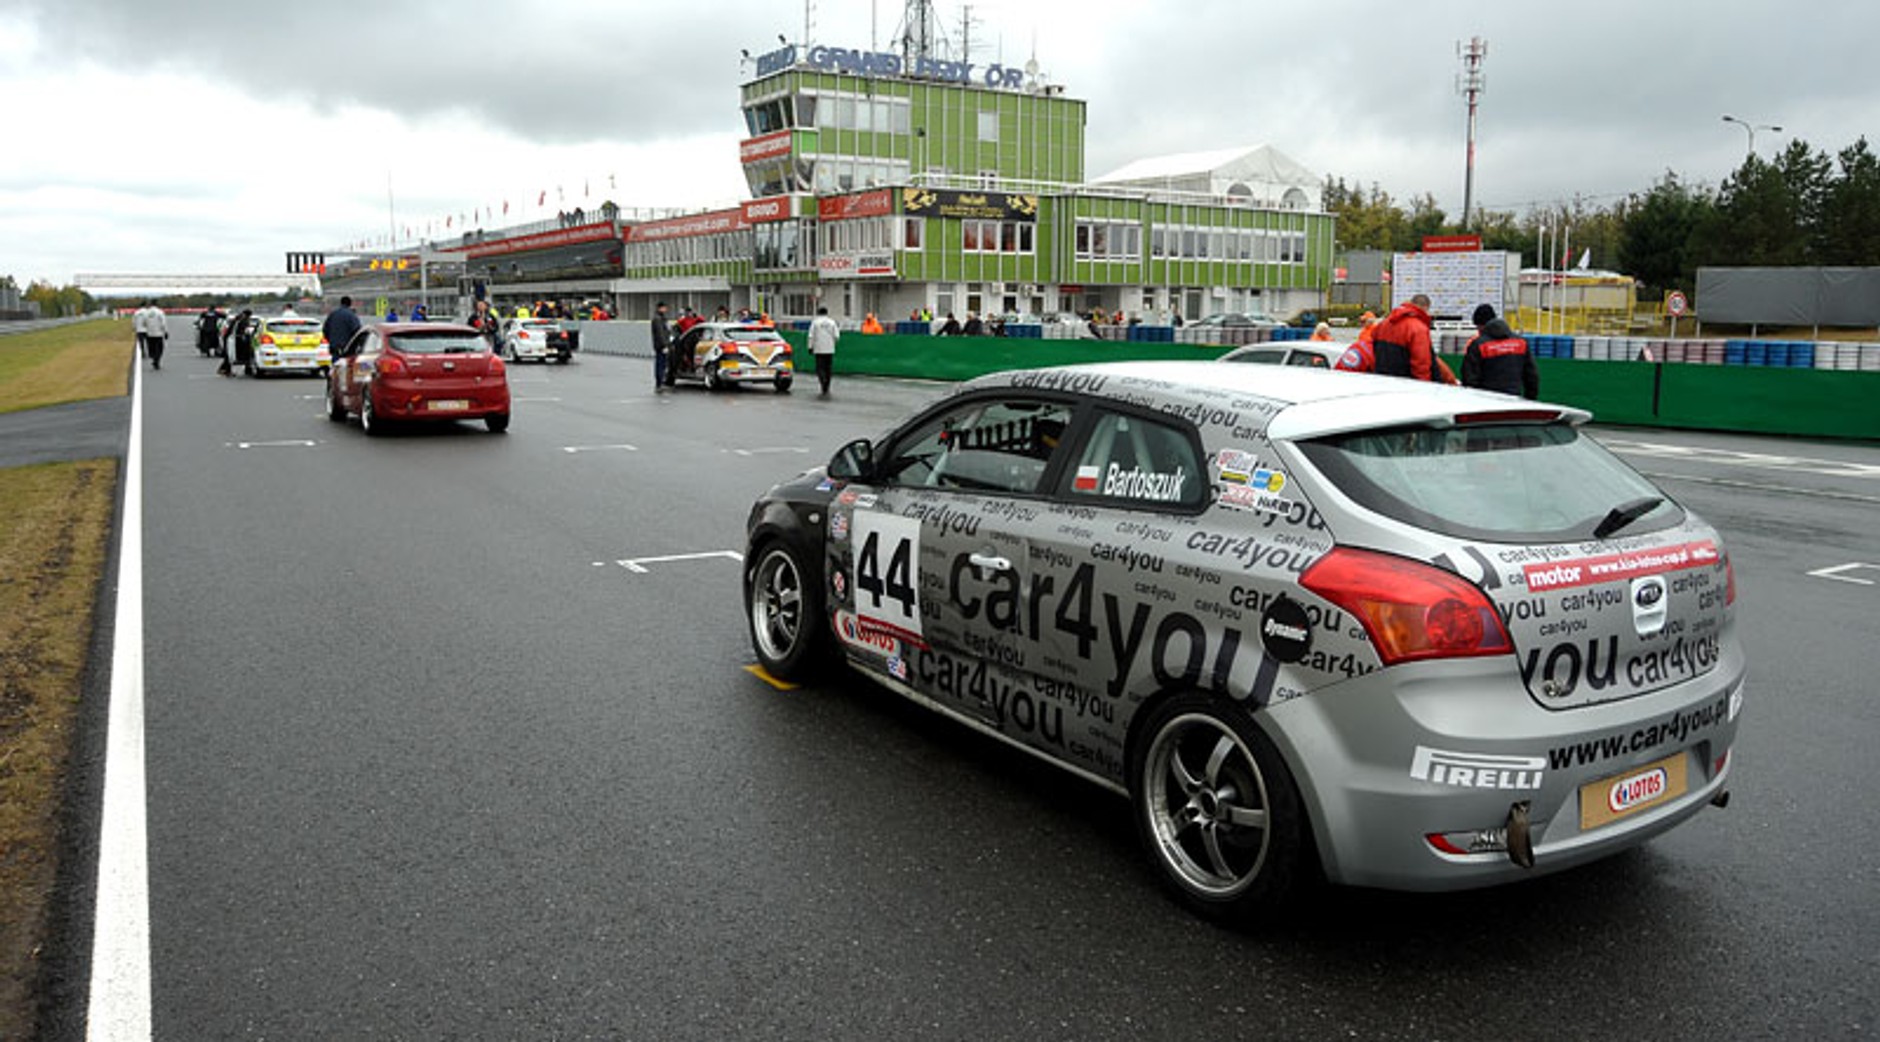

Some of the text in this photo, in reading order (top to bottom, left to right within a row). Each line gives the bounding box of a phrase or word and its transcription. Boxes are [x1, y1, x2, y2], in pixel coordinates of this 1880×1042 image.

[807, 46, 901, 75] GRAND
[916, 56, 974, 83] PRIX
[1162, 403, 1240, 429] car4you
[1104, 462, 1184, 502] Bartoszuk
[902, 502, 982, 538] car4you
[982, 500, 1039, 523] car4you
[1116, 520, 1174, 544] car4you
[1091, 540, 1165, 573] car4you
[1186, 530, 1313, 573] car4you
[1500, 543, 1571, 564] car4you
[858, 531, 916, 618] 44
[1175, 563, 1222, 585] car4you
[1529, 565, 1582, 588] motor
[1134, 581, 1177, 602] car4you
[1561, 588, 1623, 613] car4you
[1193, 598, 1242, 621] car4you
[949, 553, 1281, 713] car4you
[1539, 619, 1588, 637] car4you
[918, 651, 1065, 749] car4you
[1034, 675, 1115, 724] car4you
[1549, 698, 1729, 771] www.car4you.pl
[1410, 746, 1548, 790] PIRELLI
[1628, 774, 1661, 801] LOTOS
